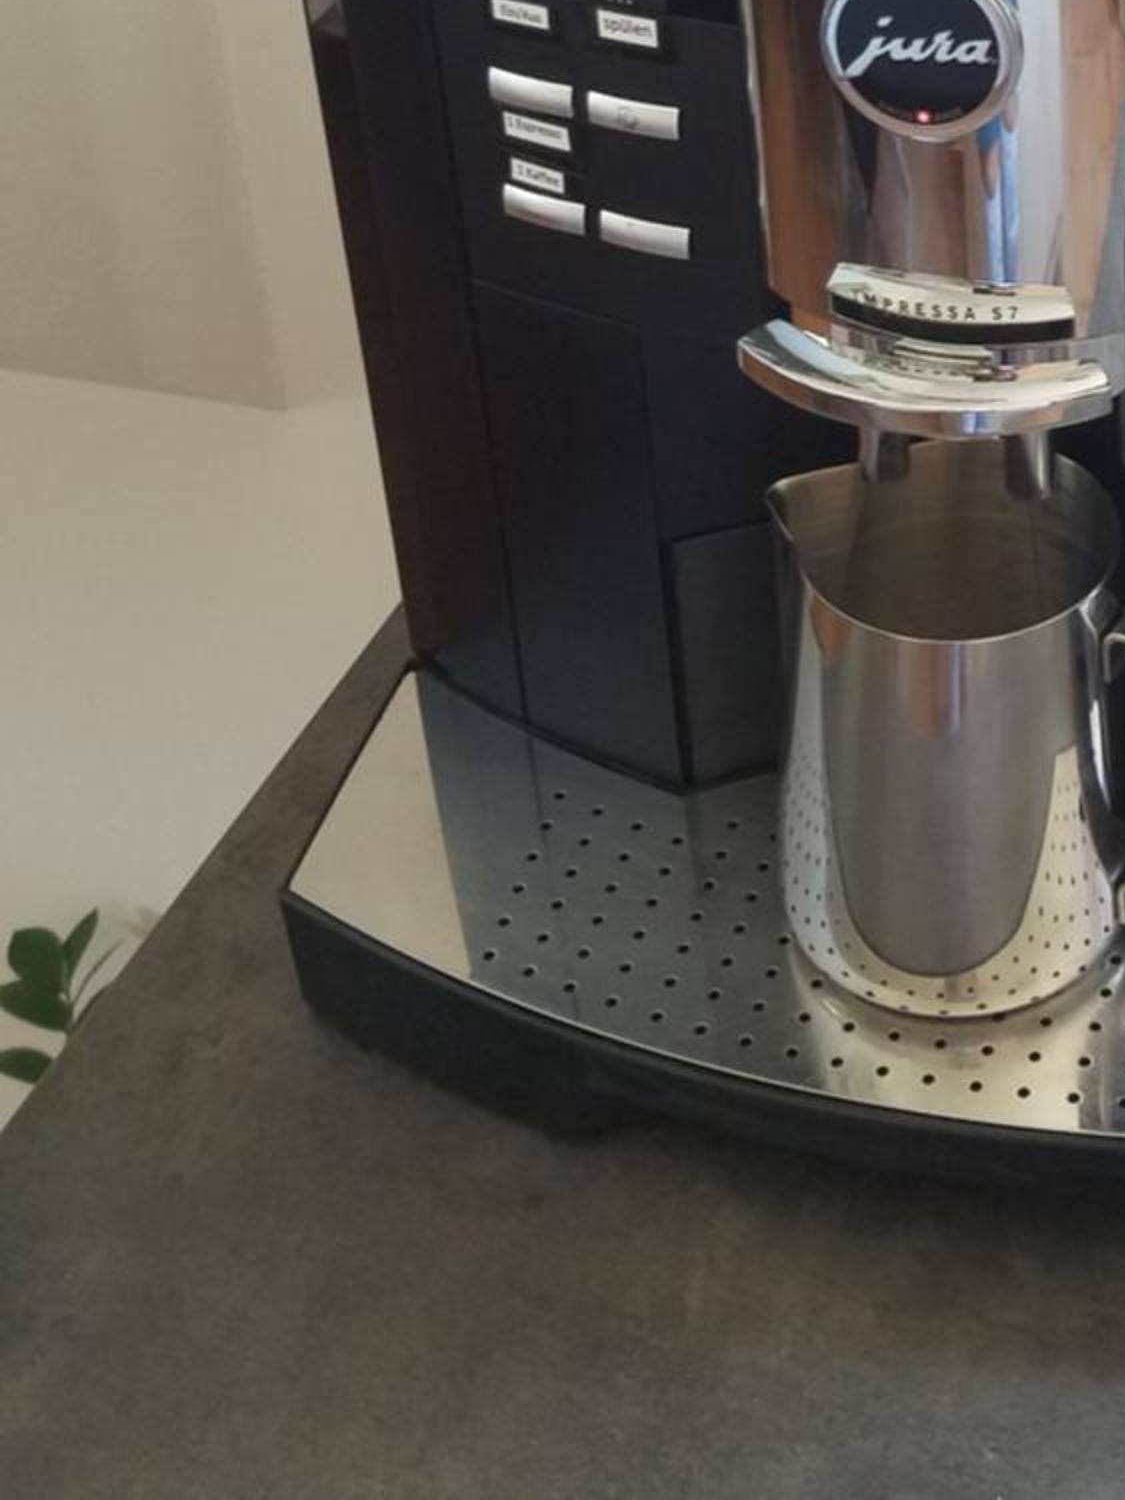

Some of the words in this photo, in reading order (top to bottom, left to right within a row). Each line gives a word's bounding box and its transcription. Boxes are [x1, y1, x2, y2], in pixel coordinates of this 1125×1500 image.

[844, 15, 993, 78] jura
[850, 288, 976, 321] IMPRESSA
[991, 305, 1019, 321] S7
